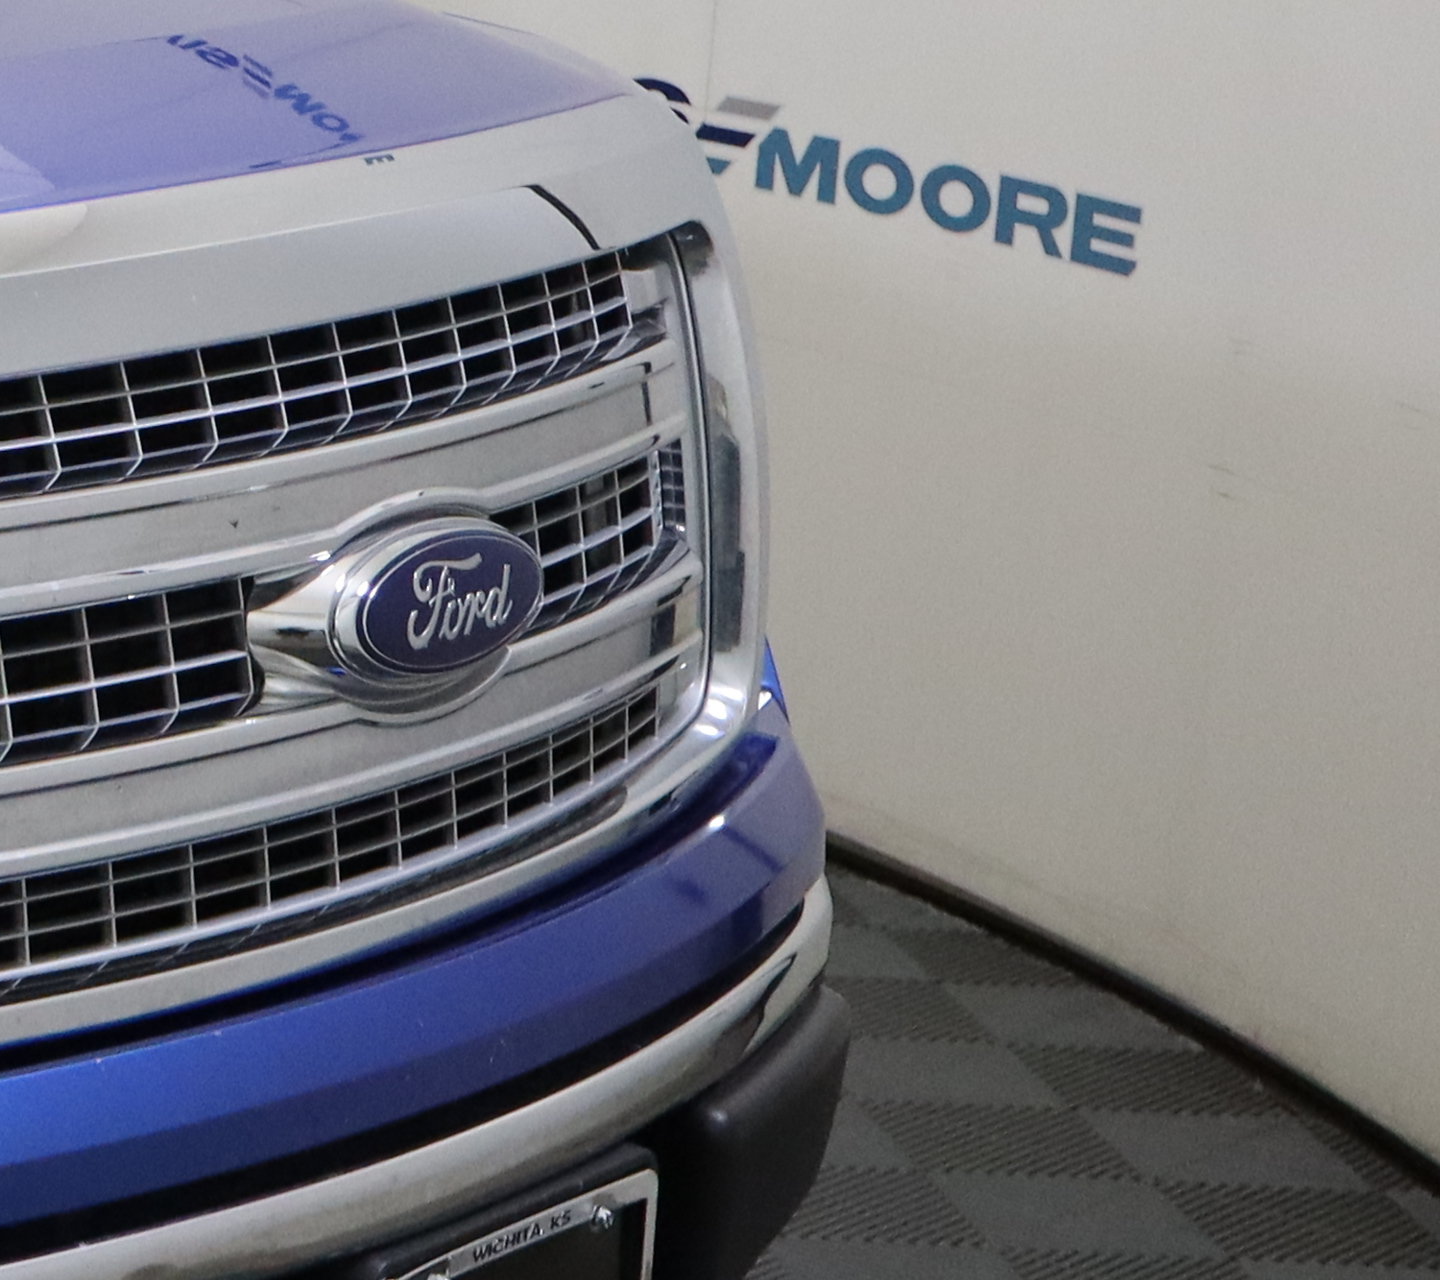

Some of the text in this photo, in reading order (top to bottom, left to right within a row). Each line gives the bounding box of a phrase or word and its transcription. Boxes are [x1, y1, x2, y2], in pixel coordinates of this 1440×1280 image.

[754, 127, 1142, 278] MOORE
[406, 551, 514, 651] Ford
[550, 1208, 573, 1231] KS
